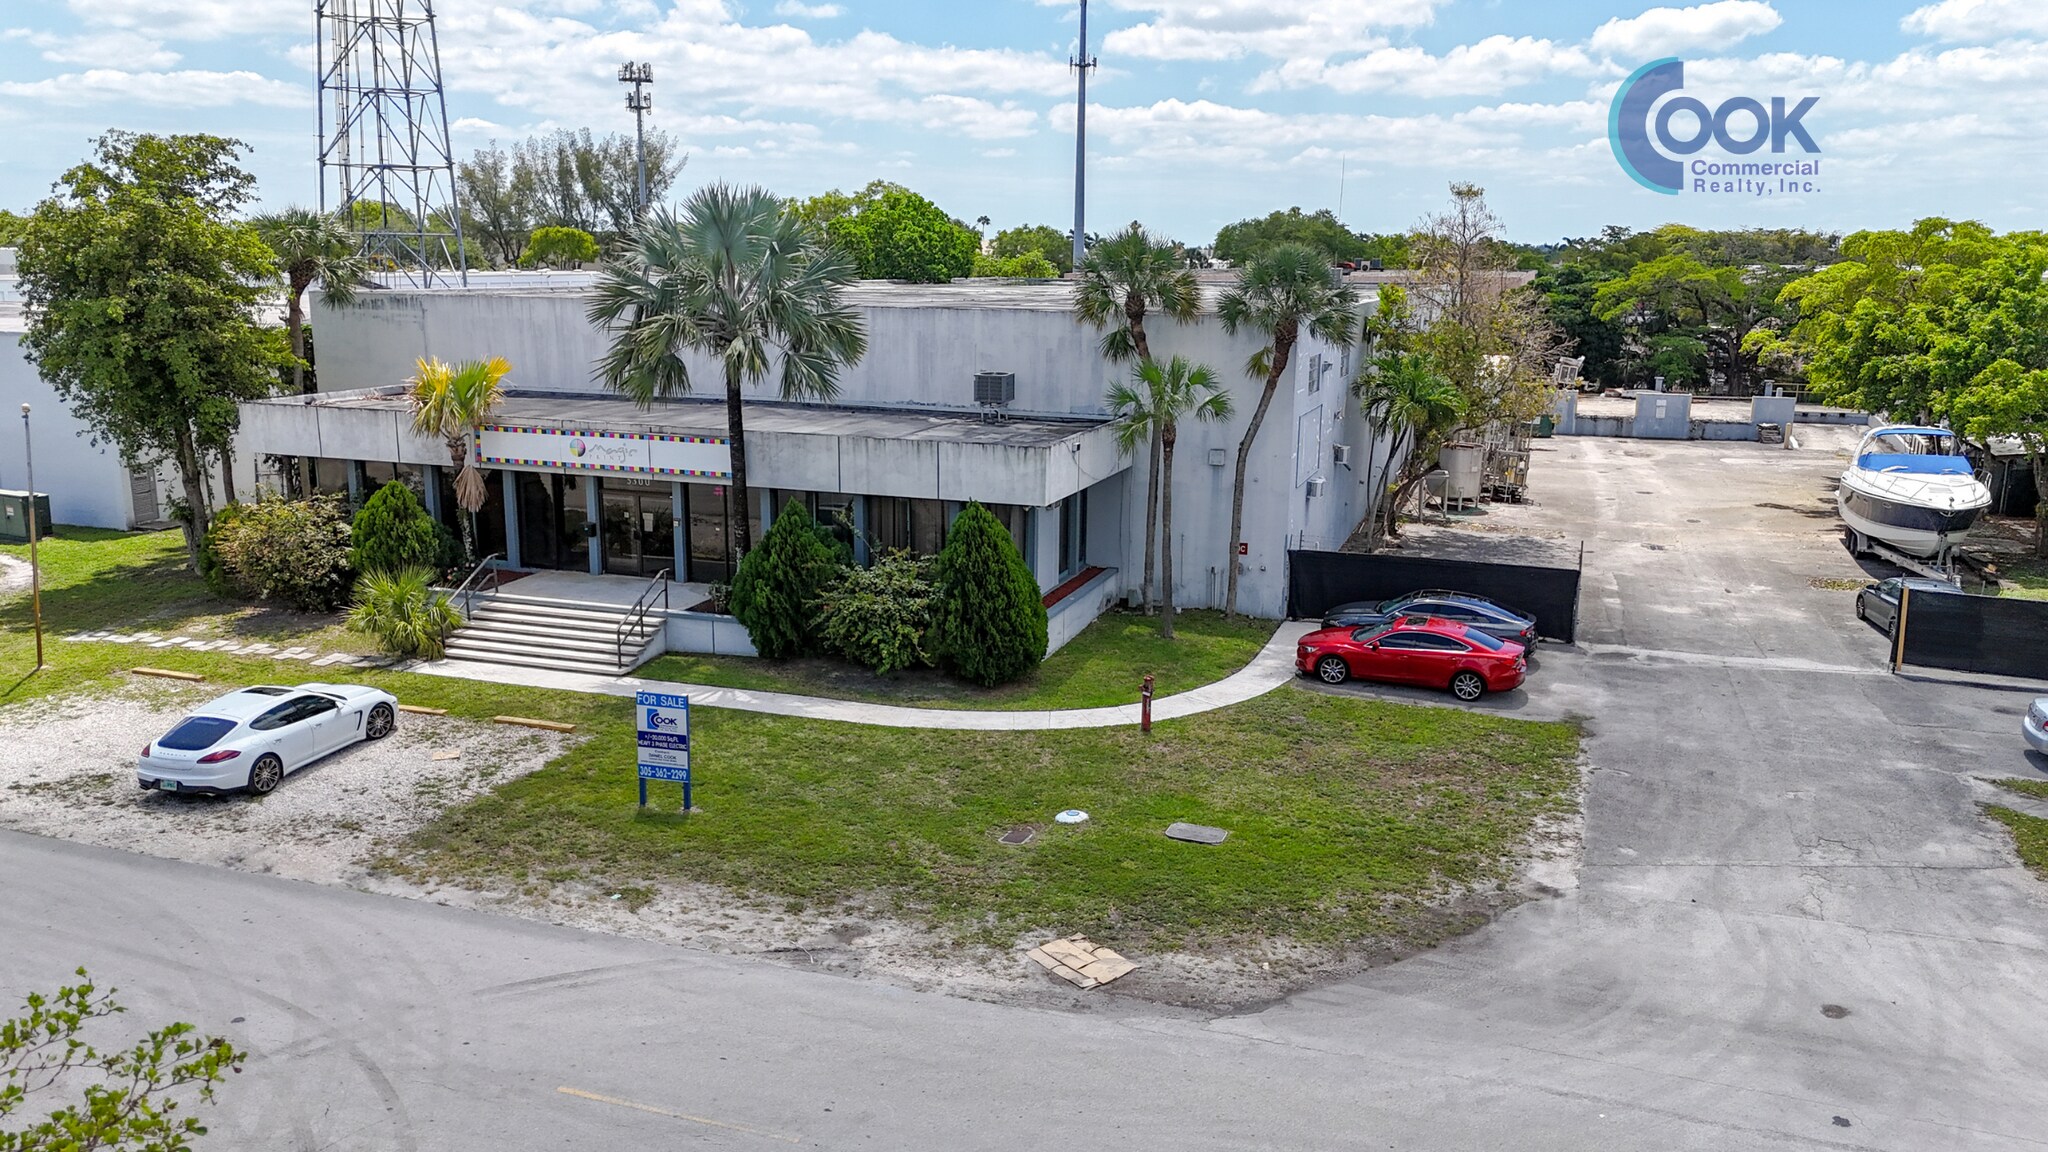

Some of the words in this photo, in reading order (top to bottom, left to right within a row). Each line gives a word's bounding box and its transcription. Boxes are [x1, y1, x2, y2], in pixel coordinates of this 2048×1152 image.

[588, 443, 637, 464] Magic
[637, 694, 657, 705] FOR
[660, 696, 685, 708] SALE
[649, 711, 677, 728] COOK
[639, 766, 687, 780] 305-362-2299
